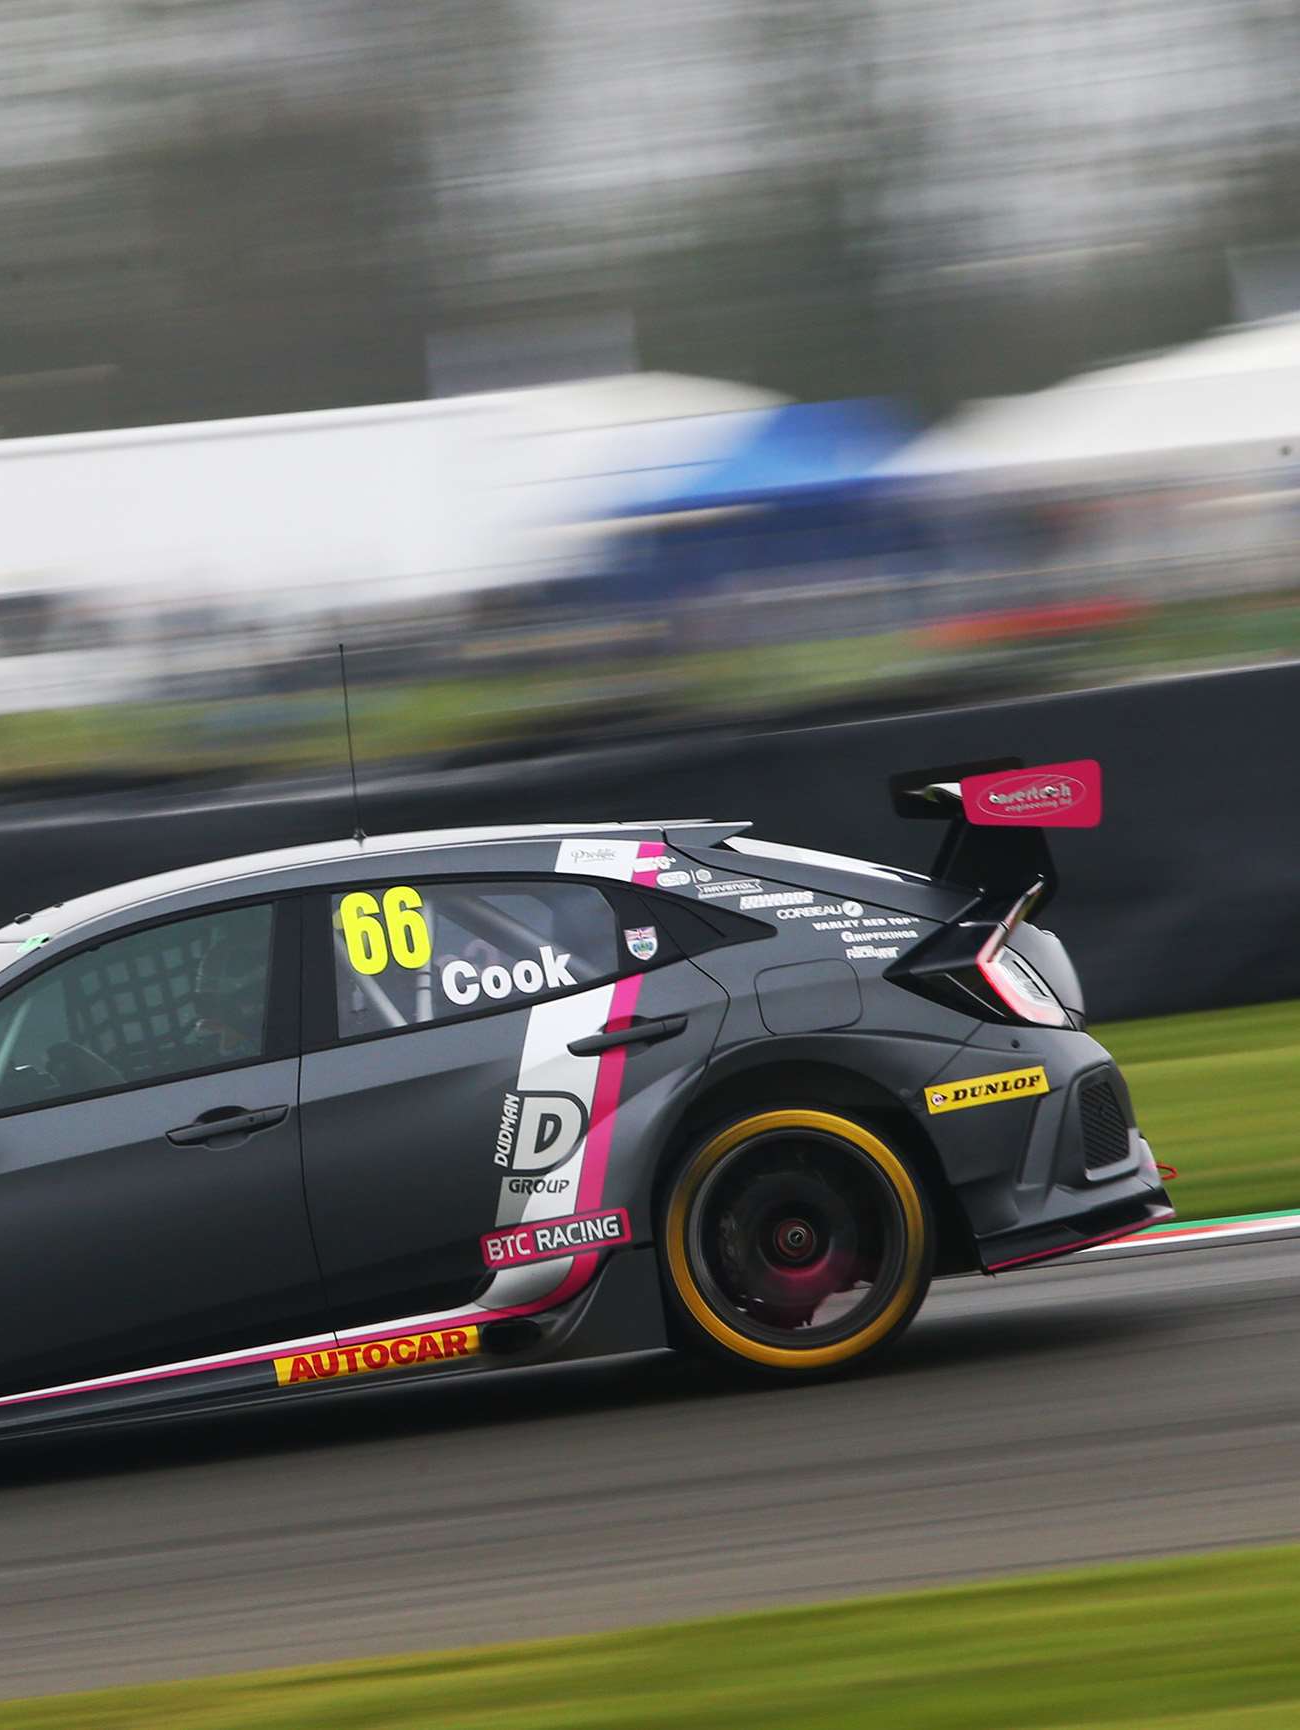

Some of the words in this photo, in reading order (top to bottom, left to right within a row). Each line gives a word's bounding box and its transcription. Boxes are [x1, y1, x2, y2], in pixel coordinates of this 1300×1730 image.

[340, 885, 432, 976] 66
[775, 904, 843, 920] CORBEAU
[812, 919, 860, 931] VARLEY
[862, 917, 887, 927] RED
[441, 945, 578, 1006] Cook
[952, 1075, 1041, 1102] DUNLOP
[493, 1093, 520, 1168] DUDMAN
[508, 1178, 570, 1196] GROUP
[486, 1233, 531, 1261] BTC
[535, 1215, 620, 1251] RACING
[288, 1329, 469, 1383] AUTOCAR
